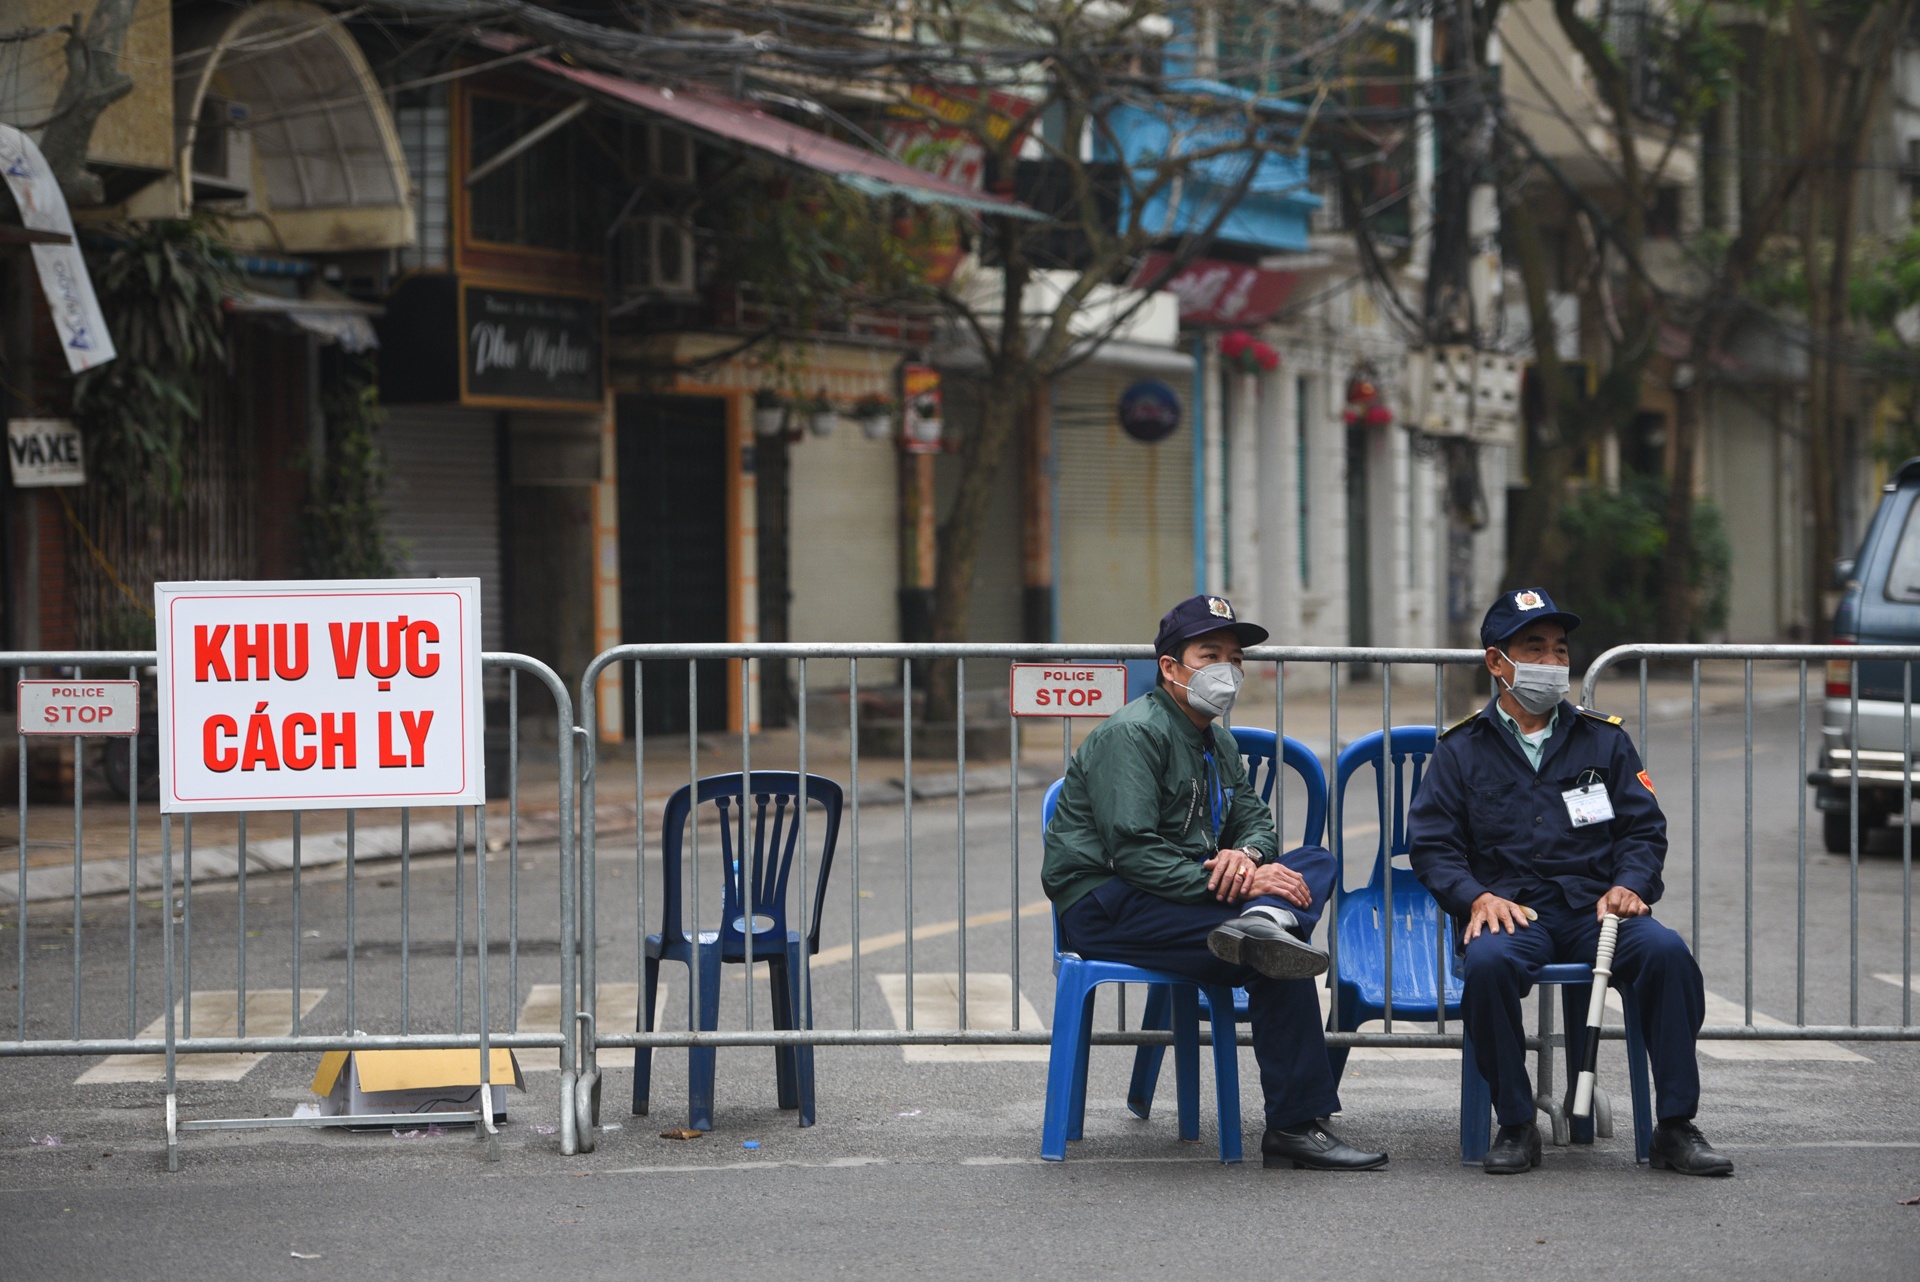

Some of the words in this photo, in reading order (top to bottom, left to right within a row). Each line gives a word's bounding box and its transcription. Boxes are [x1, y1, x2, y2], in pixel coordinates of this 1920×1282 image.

[194, 623, 309, 682] KHU
[328, 615, 440, 692] VỰC
[1043, 671, 1095, 681] POLICE
[52, 687, 105, 698] POLICE
[1035, 688, 1103, 707] STOP
[44, 705, 114, 723] STOP
[203, 701, 357, 774] CÁCH
[378, 711, 434, 769] LY
